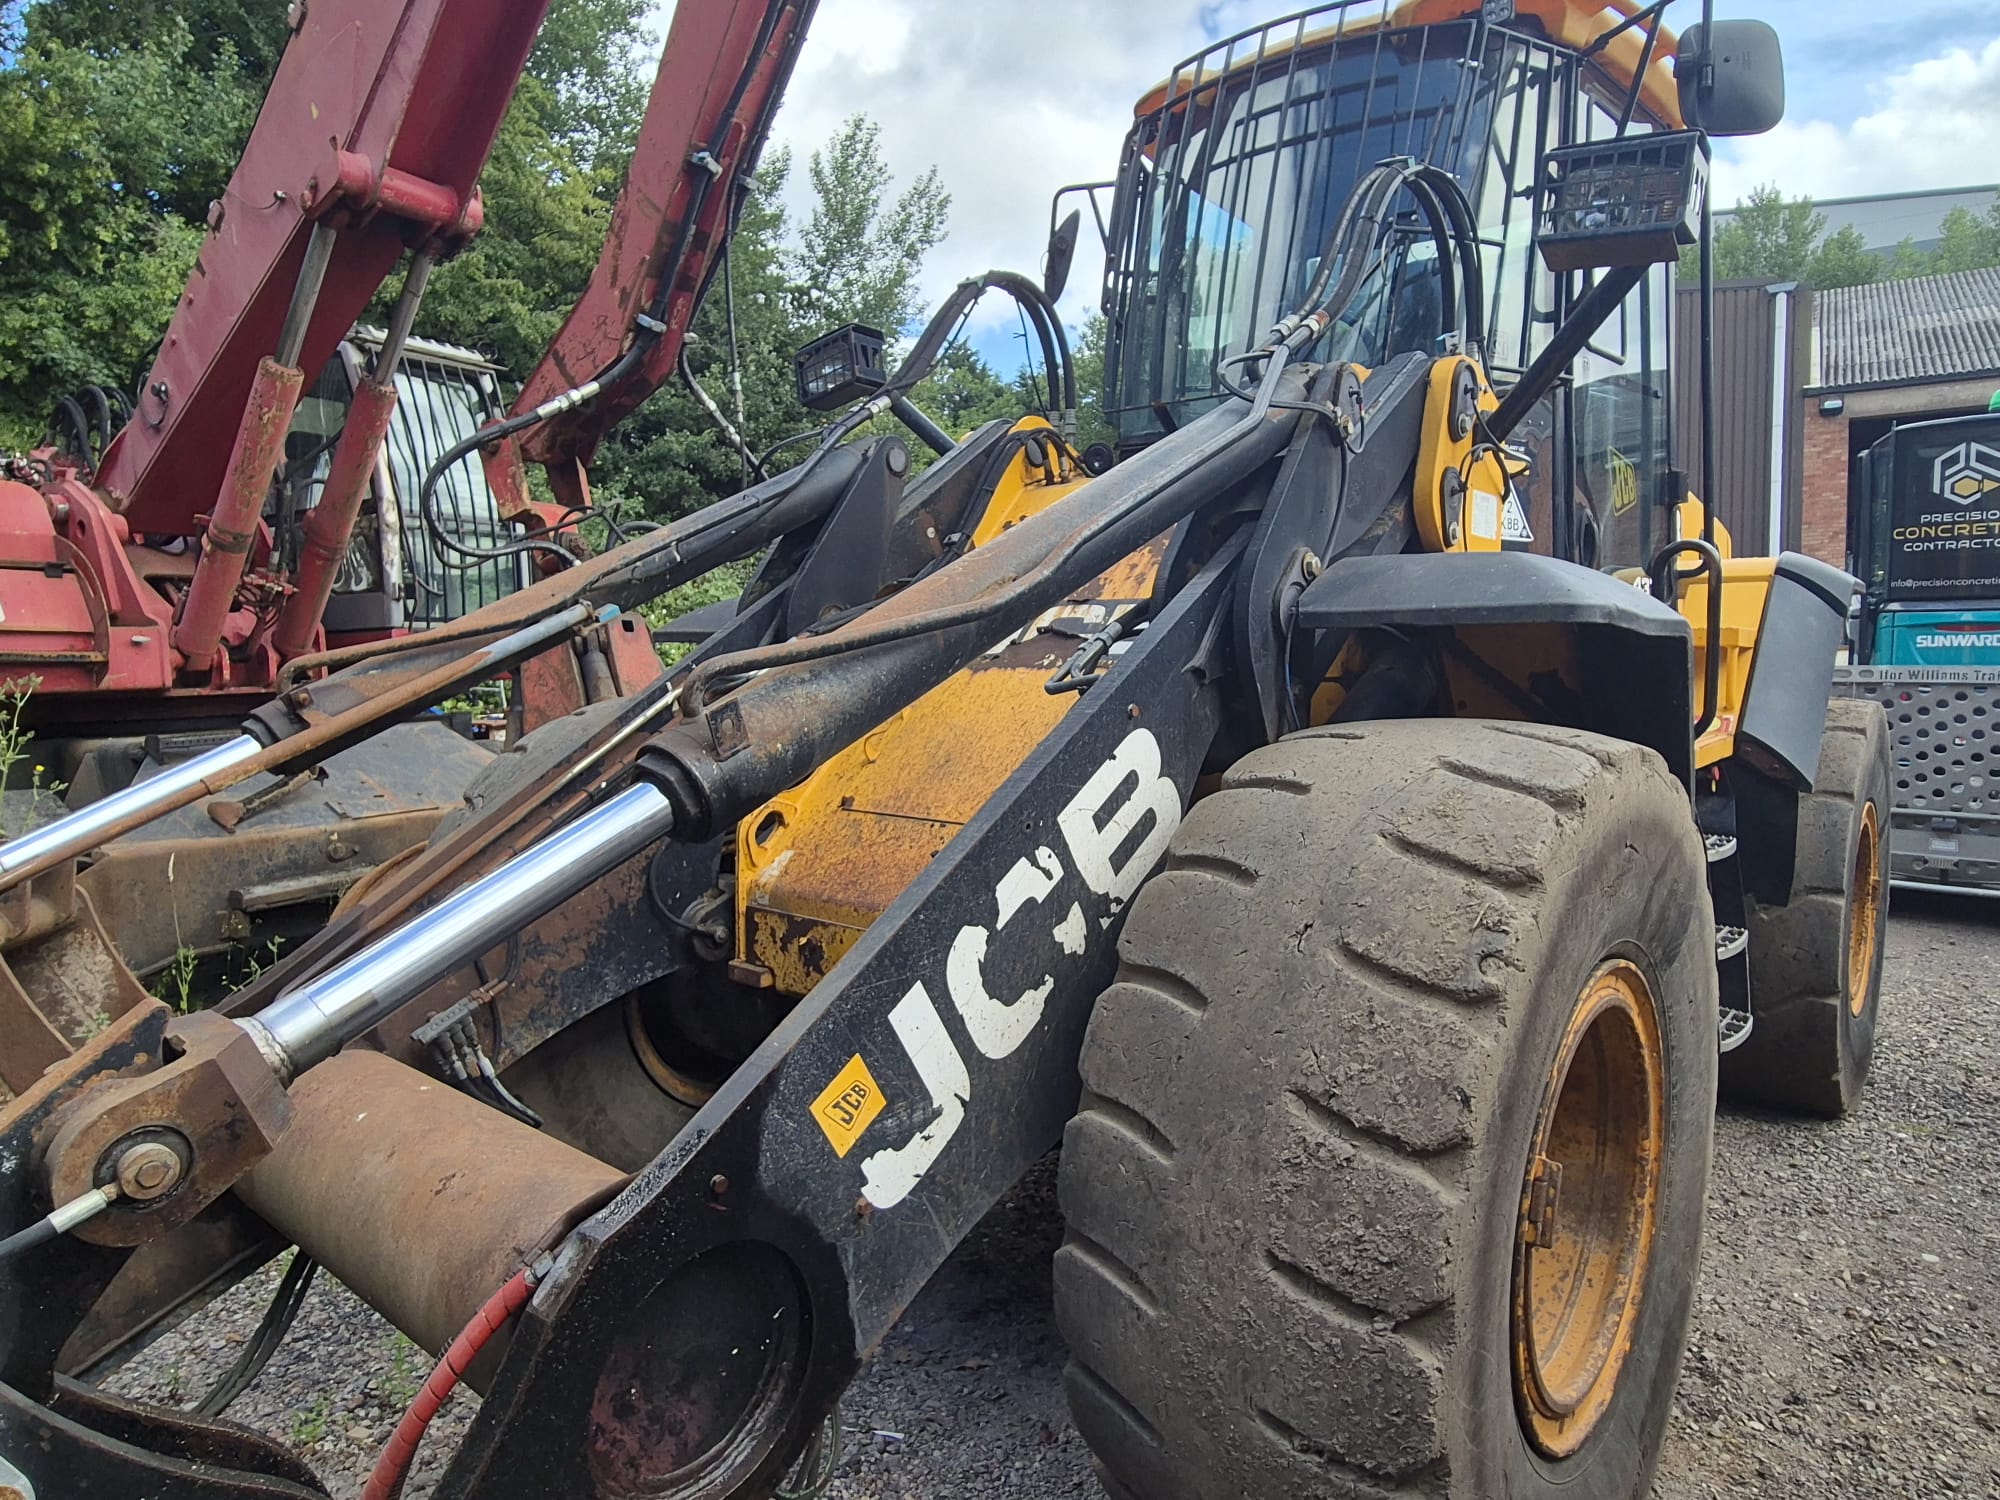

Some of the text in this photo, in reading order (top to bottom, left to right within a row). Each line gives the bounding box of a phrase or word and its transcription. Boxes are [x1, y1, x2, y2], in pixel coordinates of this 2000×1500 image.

[1613, 454, 1635, 510] JCB
[1920, 510, 2000, 524] PRECISIO
[1893, 521, 2000, 539] CONCRET
[1891, 576, 2000, 589] info@precisionconcreti
[1907, 669, 1968, 681] Williams
[860, 727, 1182, 1210] JCB
[832, 1084, 868, 1125] JCB
